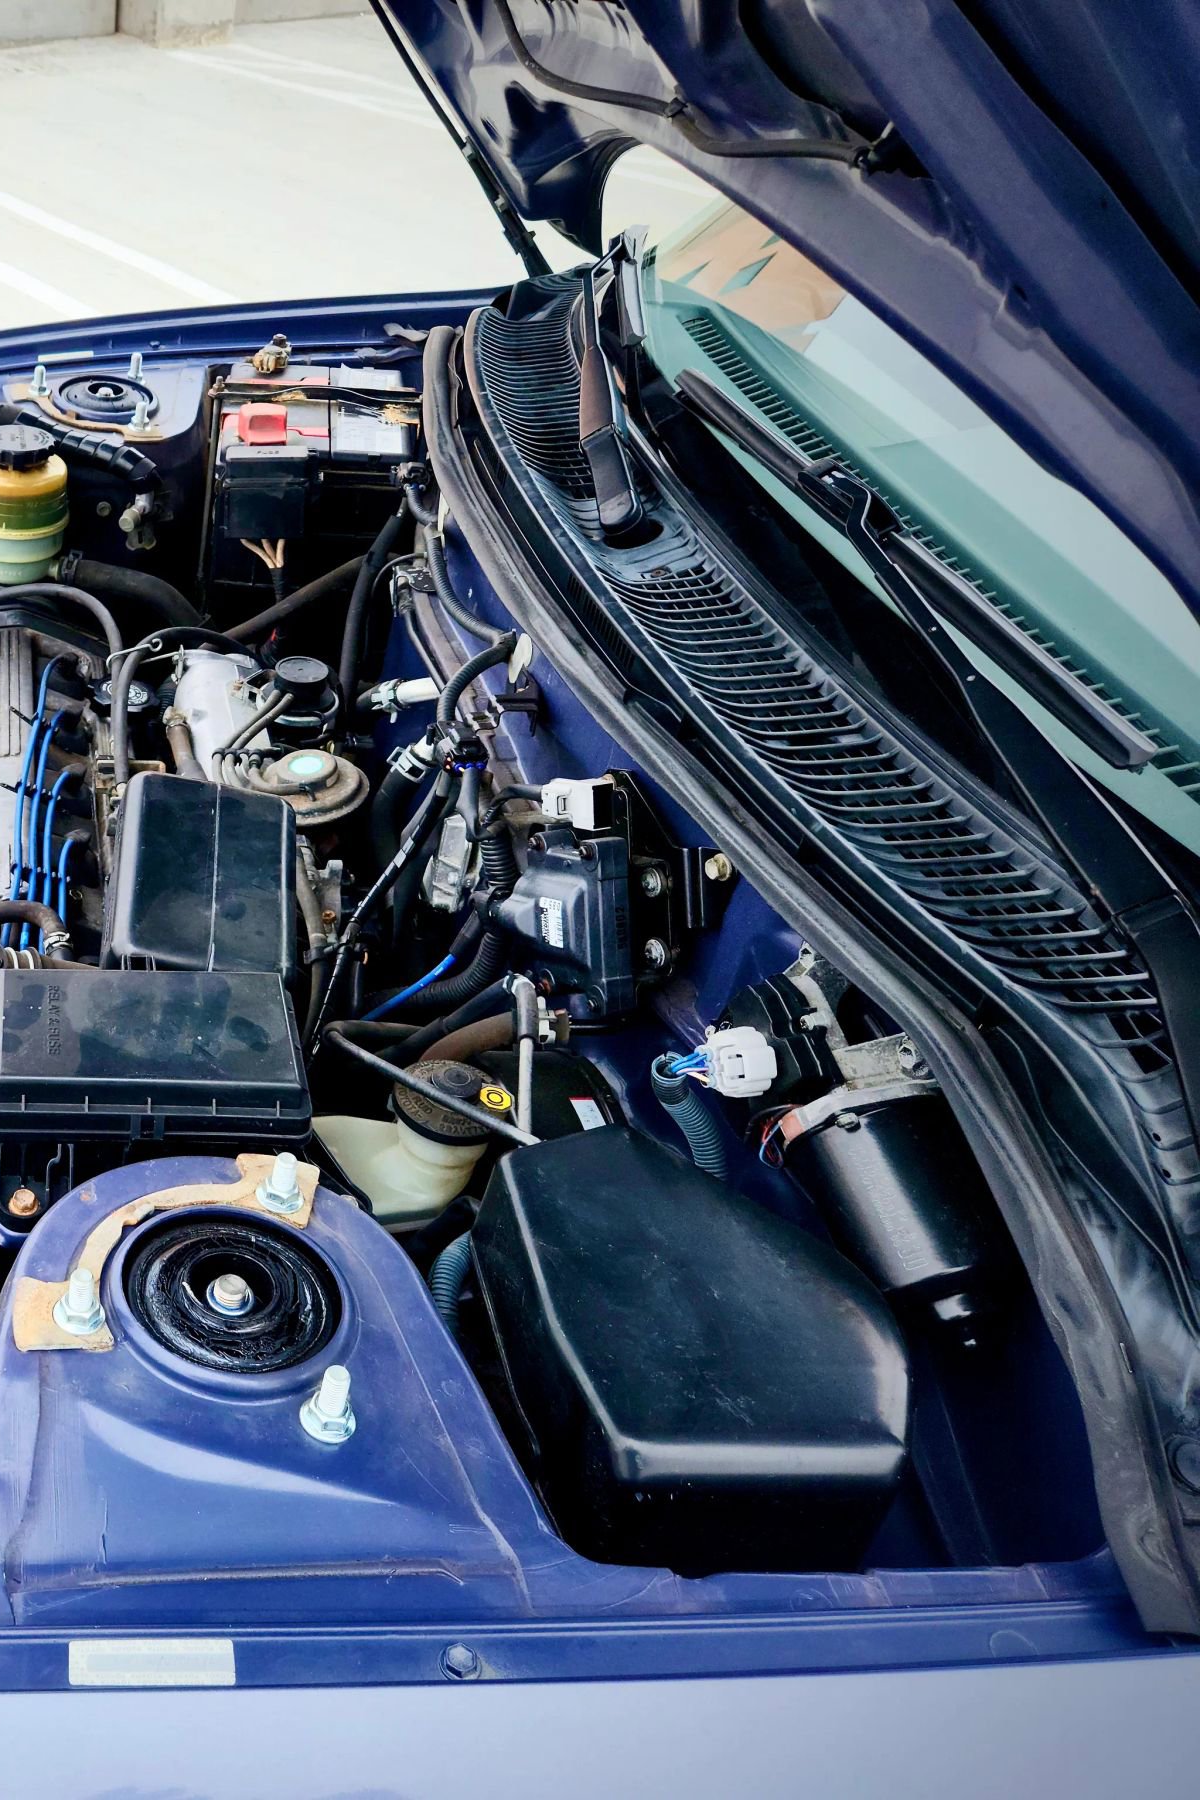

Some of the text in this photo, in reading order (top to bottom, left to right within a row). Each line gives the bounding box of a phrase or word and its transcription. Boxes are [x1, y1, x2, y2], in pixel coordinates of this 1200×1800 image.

[47, 984, 61, 1056] RELAY & FUSE
